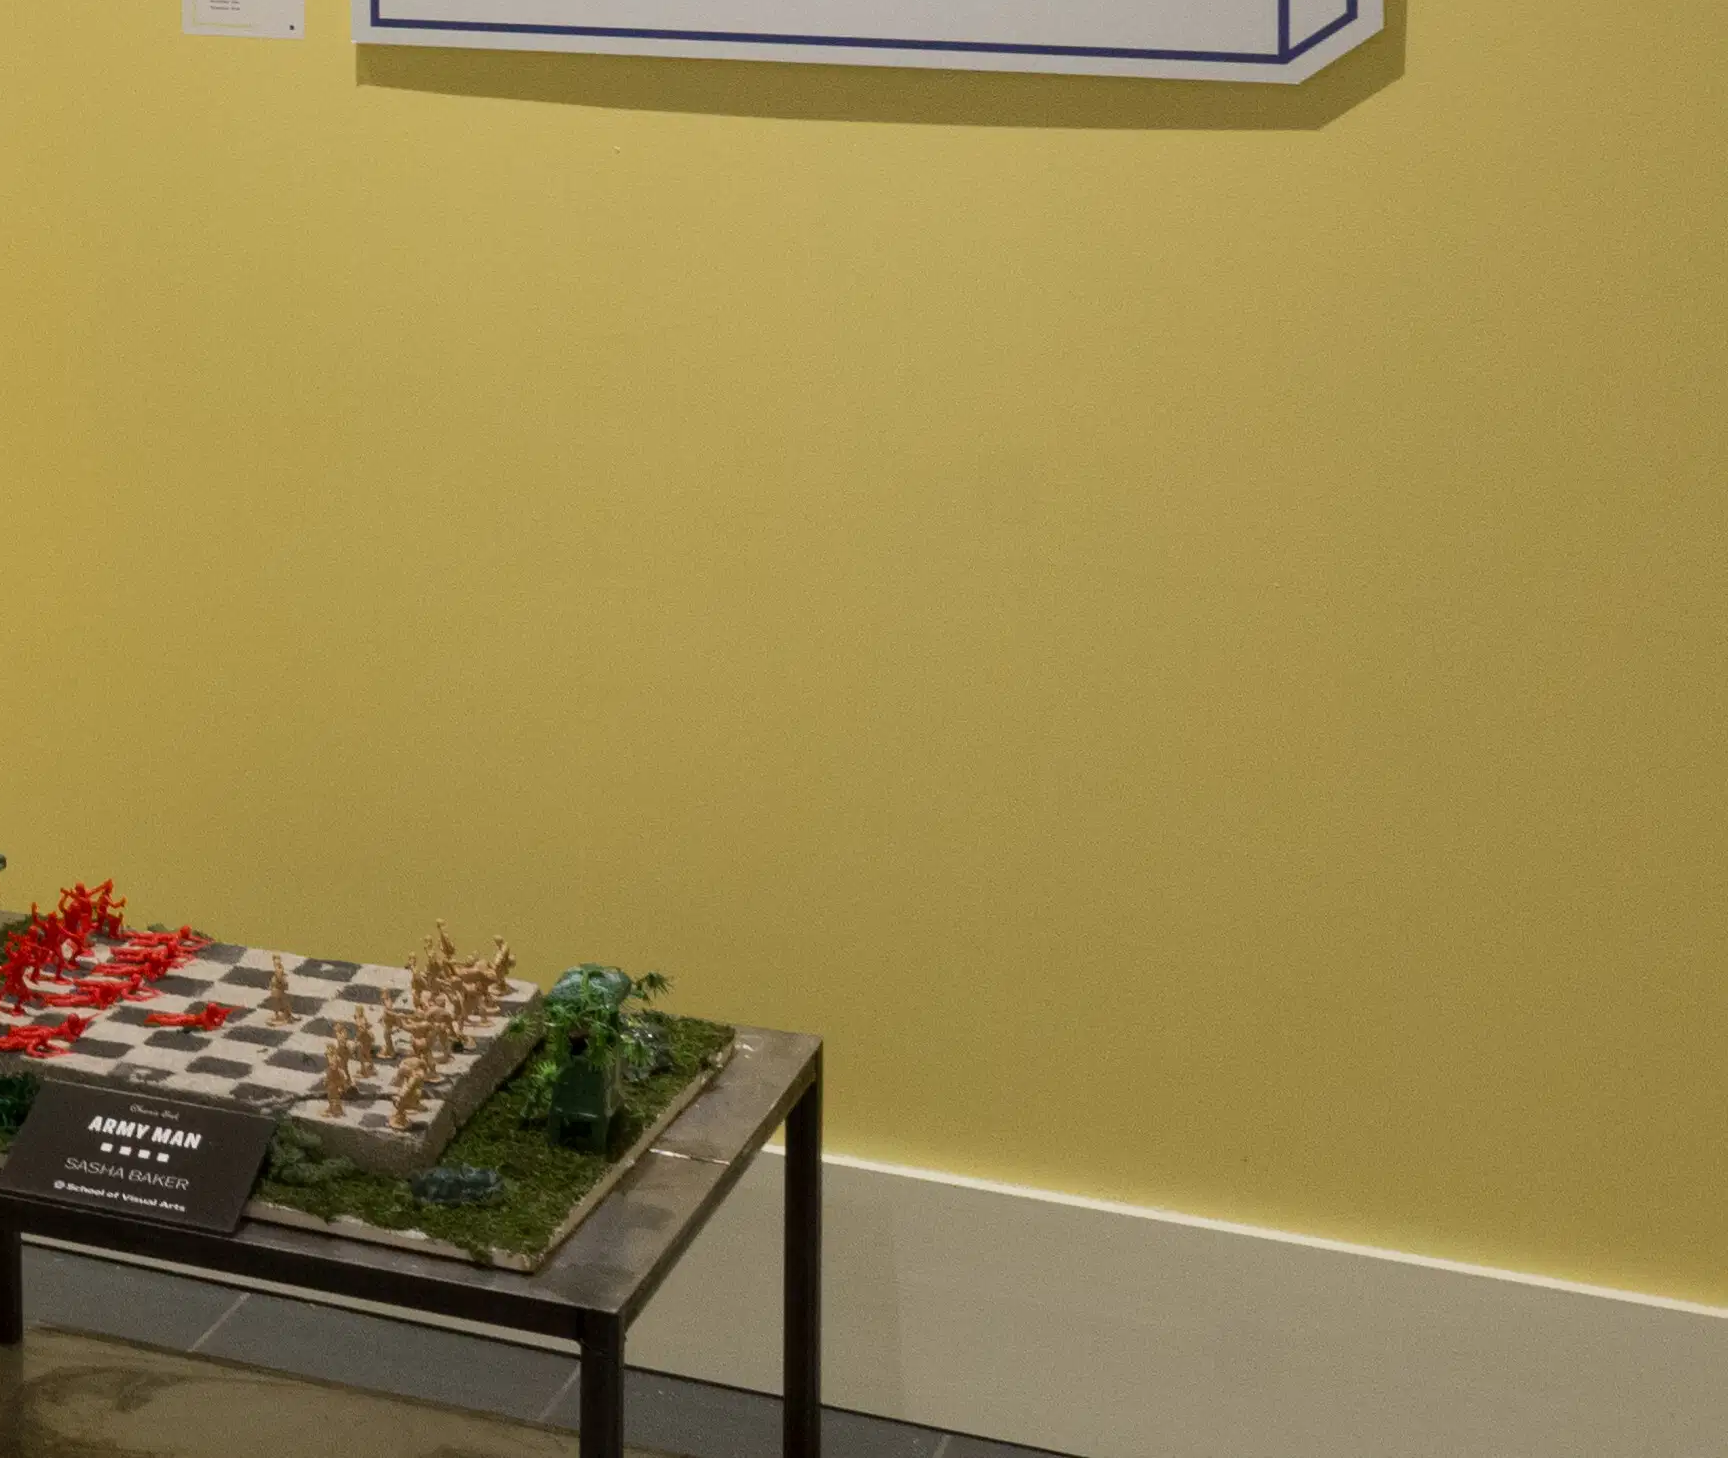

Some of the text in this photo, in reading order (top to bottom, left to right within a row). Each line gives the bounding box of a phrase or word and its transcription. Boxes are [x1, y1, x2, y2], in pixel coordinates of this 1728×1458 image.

[87, 1115, 202, 1150] ARMY MAN
[64, 1157, 190, 1191] SASHA BAKER
[66, 1182, 186, 1213] School of Visual Arts
